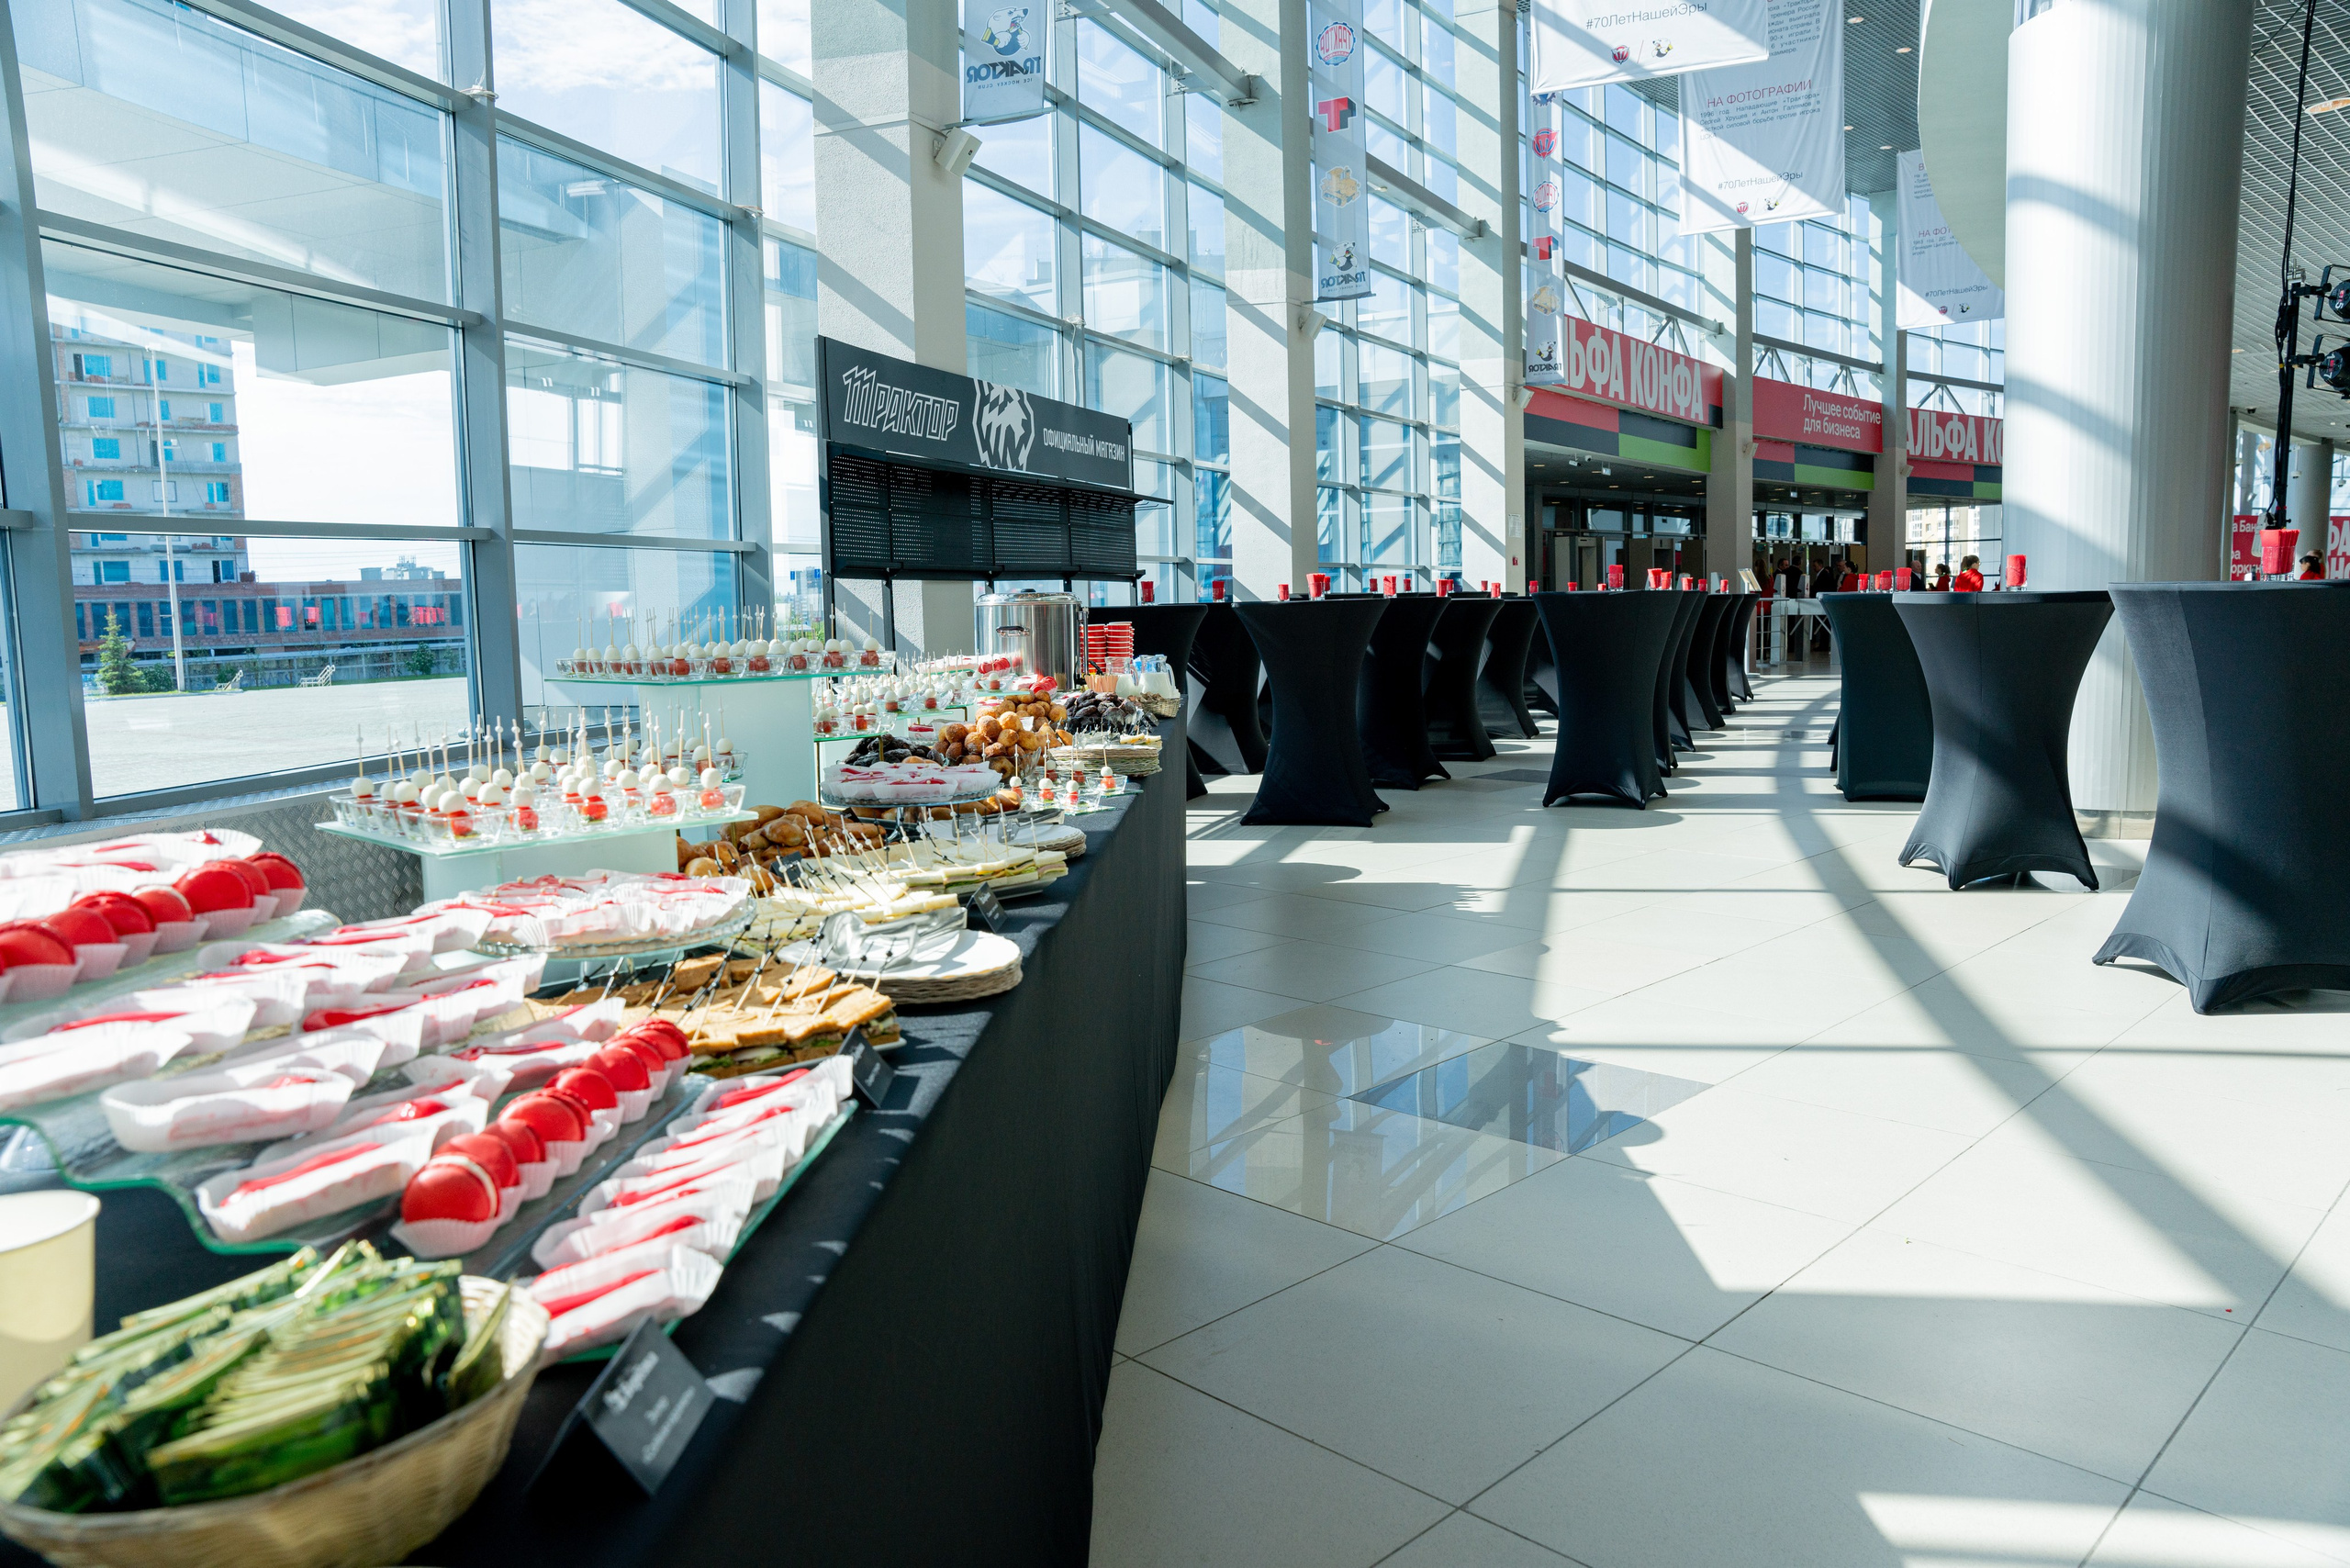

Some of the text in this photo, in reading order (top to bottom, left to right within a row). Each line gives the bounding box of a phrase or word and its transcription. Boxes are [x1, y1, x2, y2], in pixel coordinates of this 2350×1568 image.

[1586, 2, 1707, 29] #70ЛетНашейЭры
[1770, 4, 1820, 19] тренера России
[1788, 11, 1820, 23] выиграла
[1780, 34, 1820, 49] участников
[1788, 28, 1811, 38] играли
[1707, 79, 1812, 108] НА ФОТОГРАФИИ
[1736, 100, 1778, 112] Нападающие
[1783, 93, 1820, 104] «Трактора»
[1699, 118, 1721, 127] Сергей
[1726, 119, 1751, 129] силовой
[1752, 116, 1774, 125] борьбе
[1776, 111, 1797, 121] против
[1799, 107, 1820, 116] игрока
[1718, 172, 1803, 190] #70ЛетНашейЭры
[1919, 230, 1930, 238] НА
[1925, 285, 1988, 297] #70ЛетНашейЭры
[1630, 339, 1704, 421] КОНФА
[843, 365, 1125, 463] ТРАКТОР ОФИЦИАЛЬНЫЙ МАГАЗИН
[1803, 394, 1882, 425] Лучшее событие
[1803, 417, 1861, 440] для бизнеса
[1907, 409, 1979, 462] АЛЬФА
